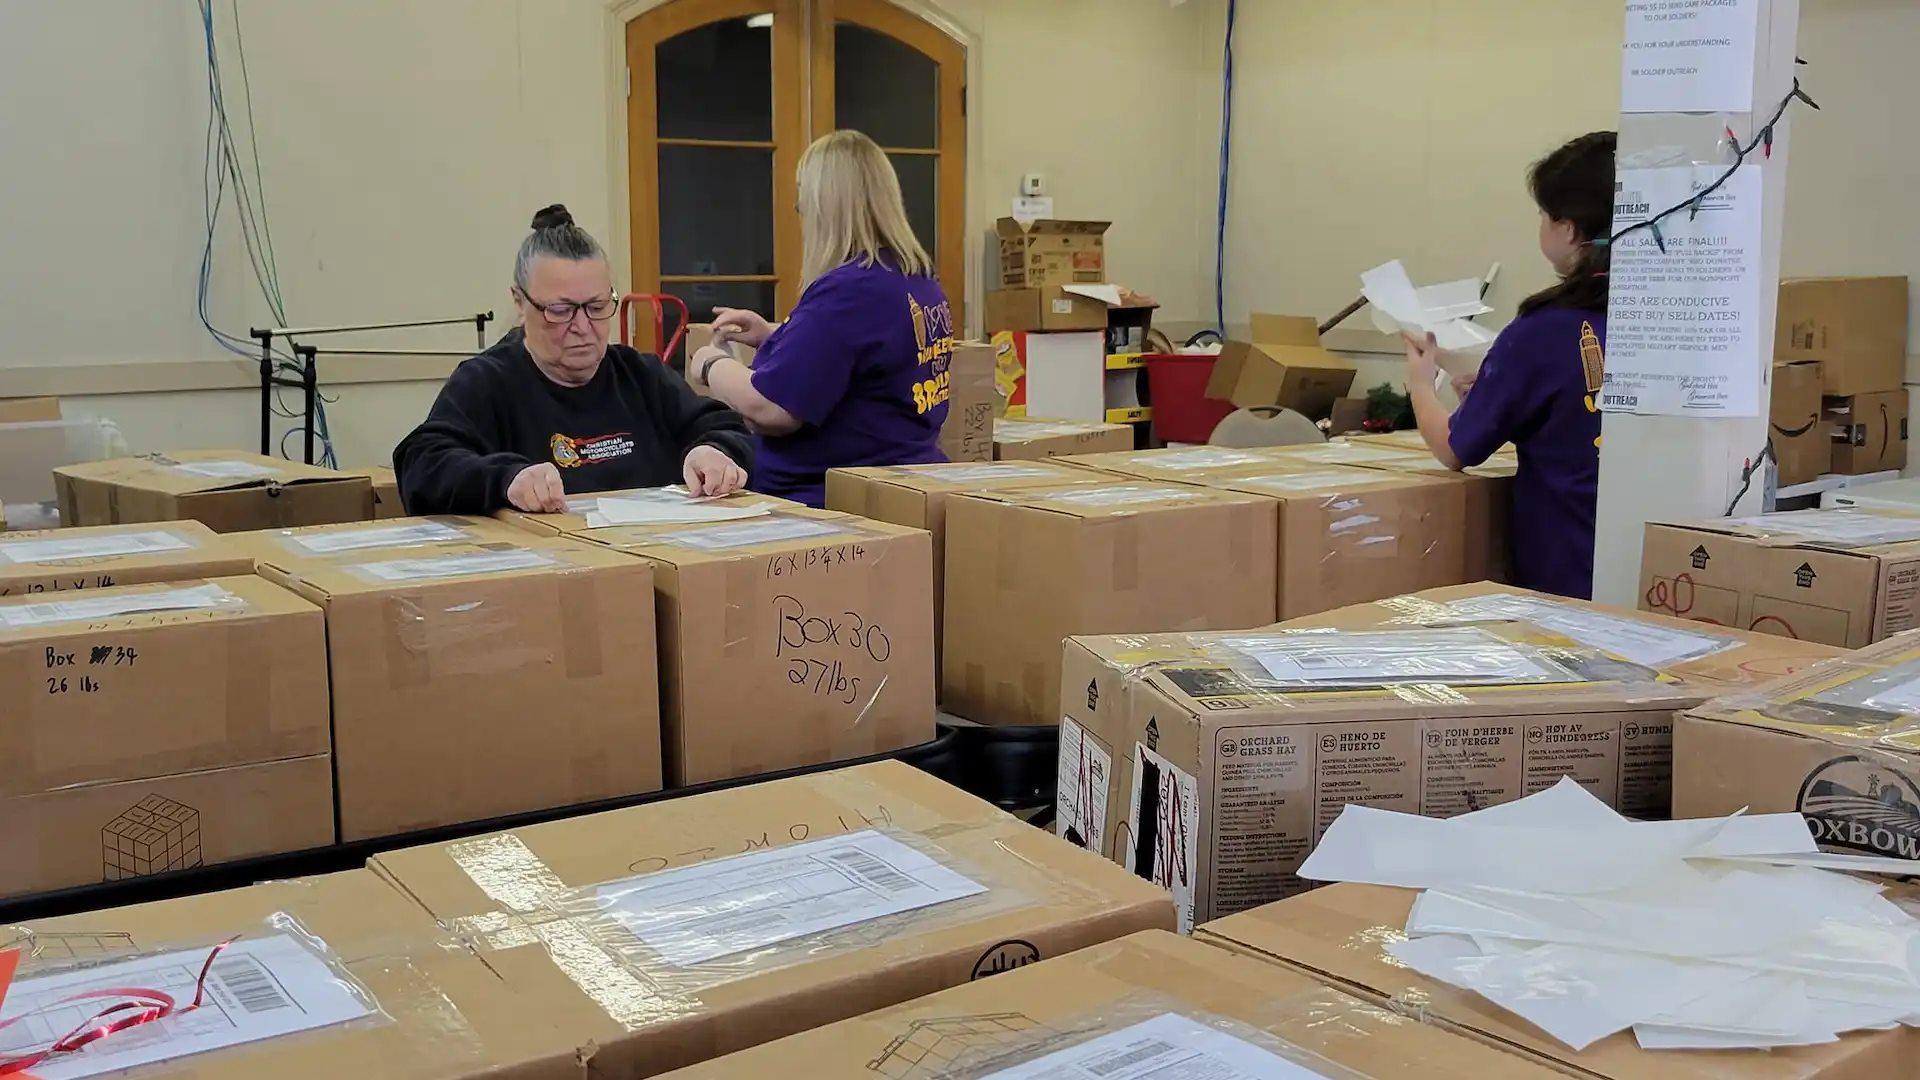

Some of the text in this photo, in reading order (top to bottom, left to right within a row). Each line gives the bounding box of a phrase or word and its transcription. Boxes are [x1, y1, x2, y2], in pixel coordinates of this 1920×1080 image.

[1658, 3, 1666, 11] TO
[1676, 39, 1731, 48] UNDERSTANDING
[1667, 67, 1698, 75] OUTREACH
[1621, 238, 1636, 247] ALL
[1667, 238, 1684, 246] ARE
[1640, 297, 1731, 306] ARE CONDUCIVE
[1614, 310, 1643, 320] BEST
[1646, 311, 1665, 321] BUY
[1668, 311, 1696, 320] SELL
[580, 440, 634, 455] MOTORCYCLISTS
[586, 437, 623, 448] CHRISTIAN
[588, 447, 632, 459] ASSOCIATION
[766, 555, 783, 579] 16
[851, 545, 866, 561] 14
[772, 595, 891, 663] Box 30
[45, 646, 76, 669] Box
[46, 675, 100, 695] 26 lbs
[1428, 727, 1514, 743] FR FOIN D'HERBE
[1529, 724, 1583, 739] NO HØY AV
[1625, 725, 1673, 736] SV HUND
[1221, 736, 1290, 753] GB ORCHARD
[1323, 732, 1386, 748] ES HENO DE
[1445, 737, 1500, 747] DE VERGER
[1240, 745, 1297, 757] GRASS HAY
[1340, 742, 1380, 752] HUERTO
[1806, 817, 1920, 860] OXBOW
